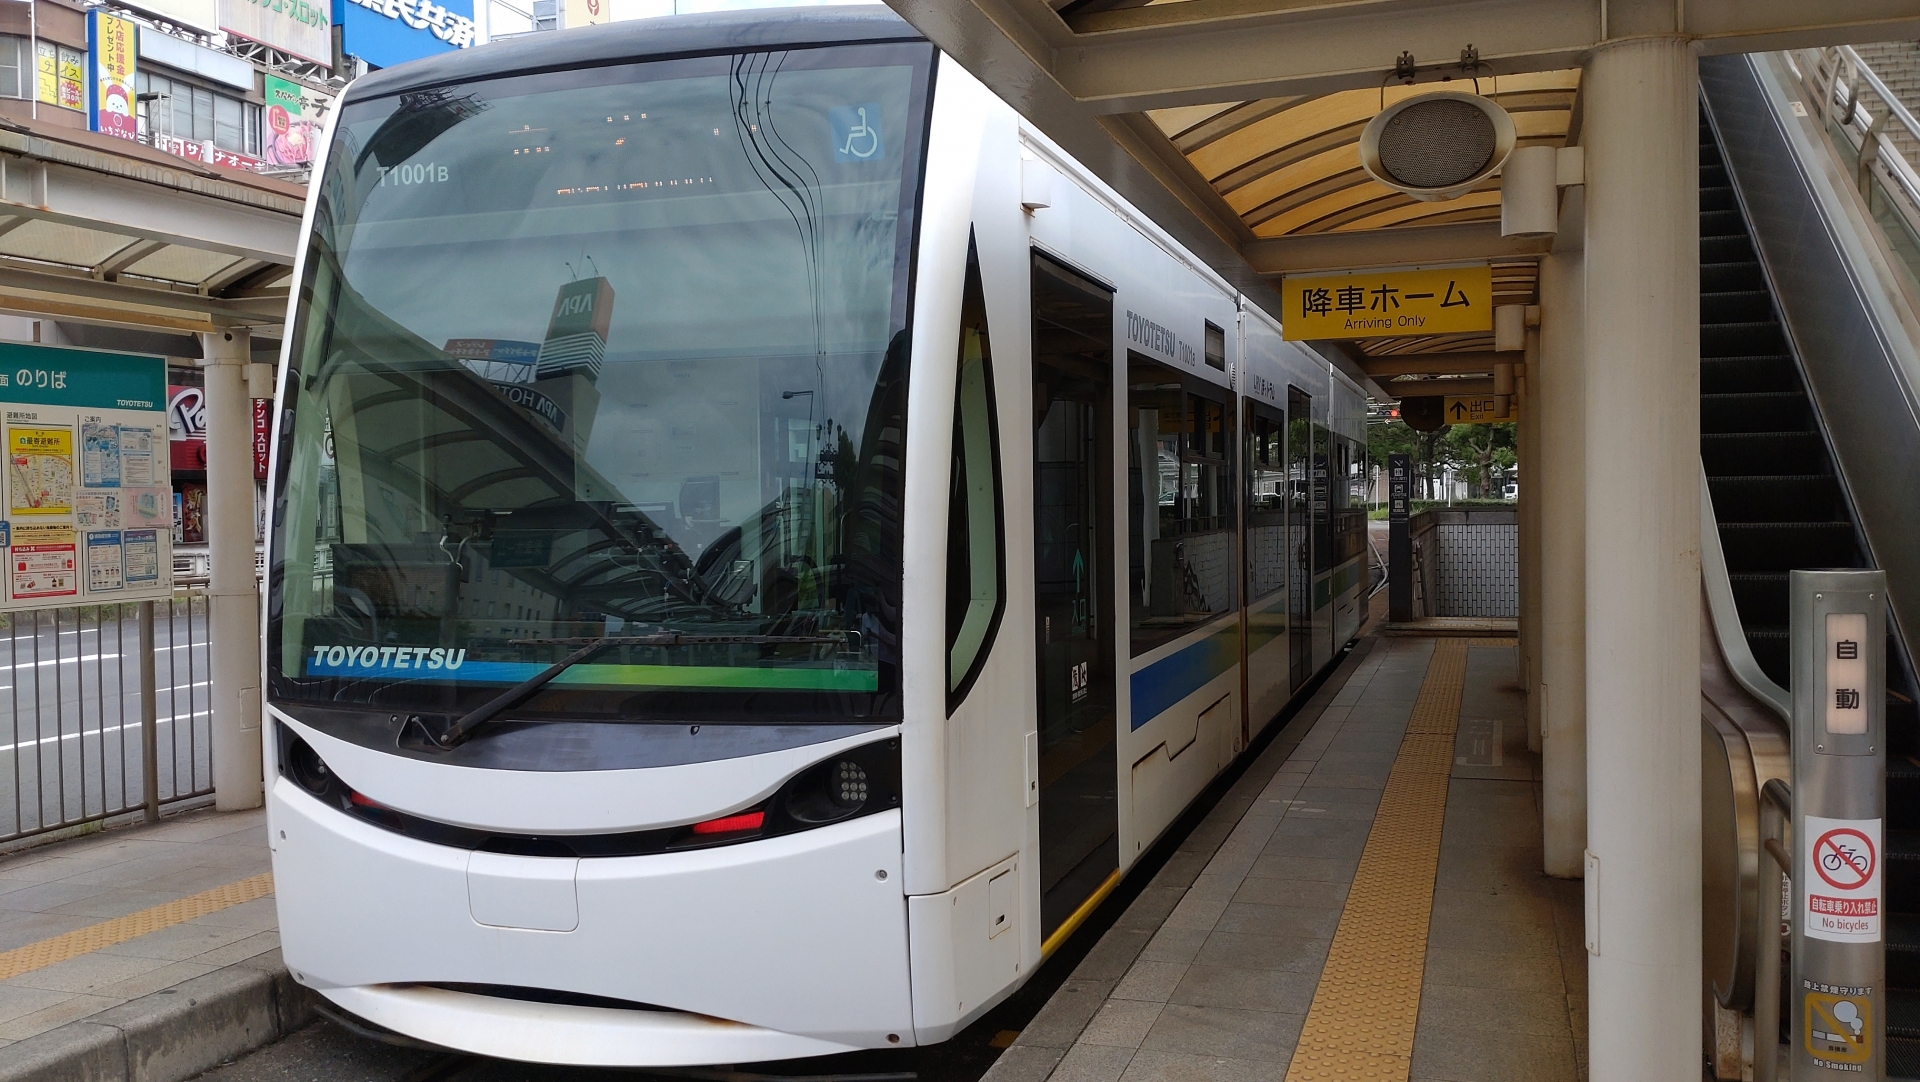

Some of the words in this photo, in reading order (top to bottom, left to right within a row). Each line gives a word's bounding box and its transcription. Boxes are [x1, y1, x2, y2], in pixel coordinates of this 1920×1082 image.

[106, 16, 115, 72] プレゼント中
[115, 19, 125, 76] 入店応援金
[100, 125, 136, 140] いちごなび
[376, 163, 450, 188] T1001B
[1302, 280, 1471, 319] 降車ホーム
[1344, 317, 1392, 330] Arriving
[1397, 315, 1427, 328] Only
[1126, 309, 1176, 358] TOYOTETSU
[16, 368, 67, 389] のりば
[116, 399, 153, 408] TOYOTETSU
[1469, 400, 1495, 413] 出口
[1469, 412, 1484, 420] Exit
[312, 645, 466, 670] TOYOTETSU
[1835, 639, 1860, 710] 自動
[1811, 897, 1877, 915] 自転車乗り入れ禁止
[1822, 917, 1834, 929] No
[1837, 917, 1869, 931] bicycles
[1803, 979, 1872, 996] 路上禁煙守ります
[1813, 1057, 1825, 1069] No
[1826, 1059, 1862, 1072] Smoking
